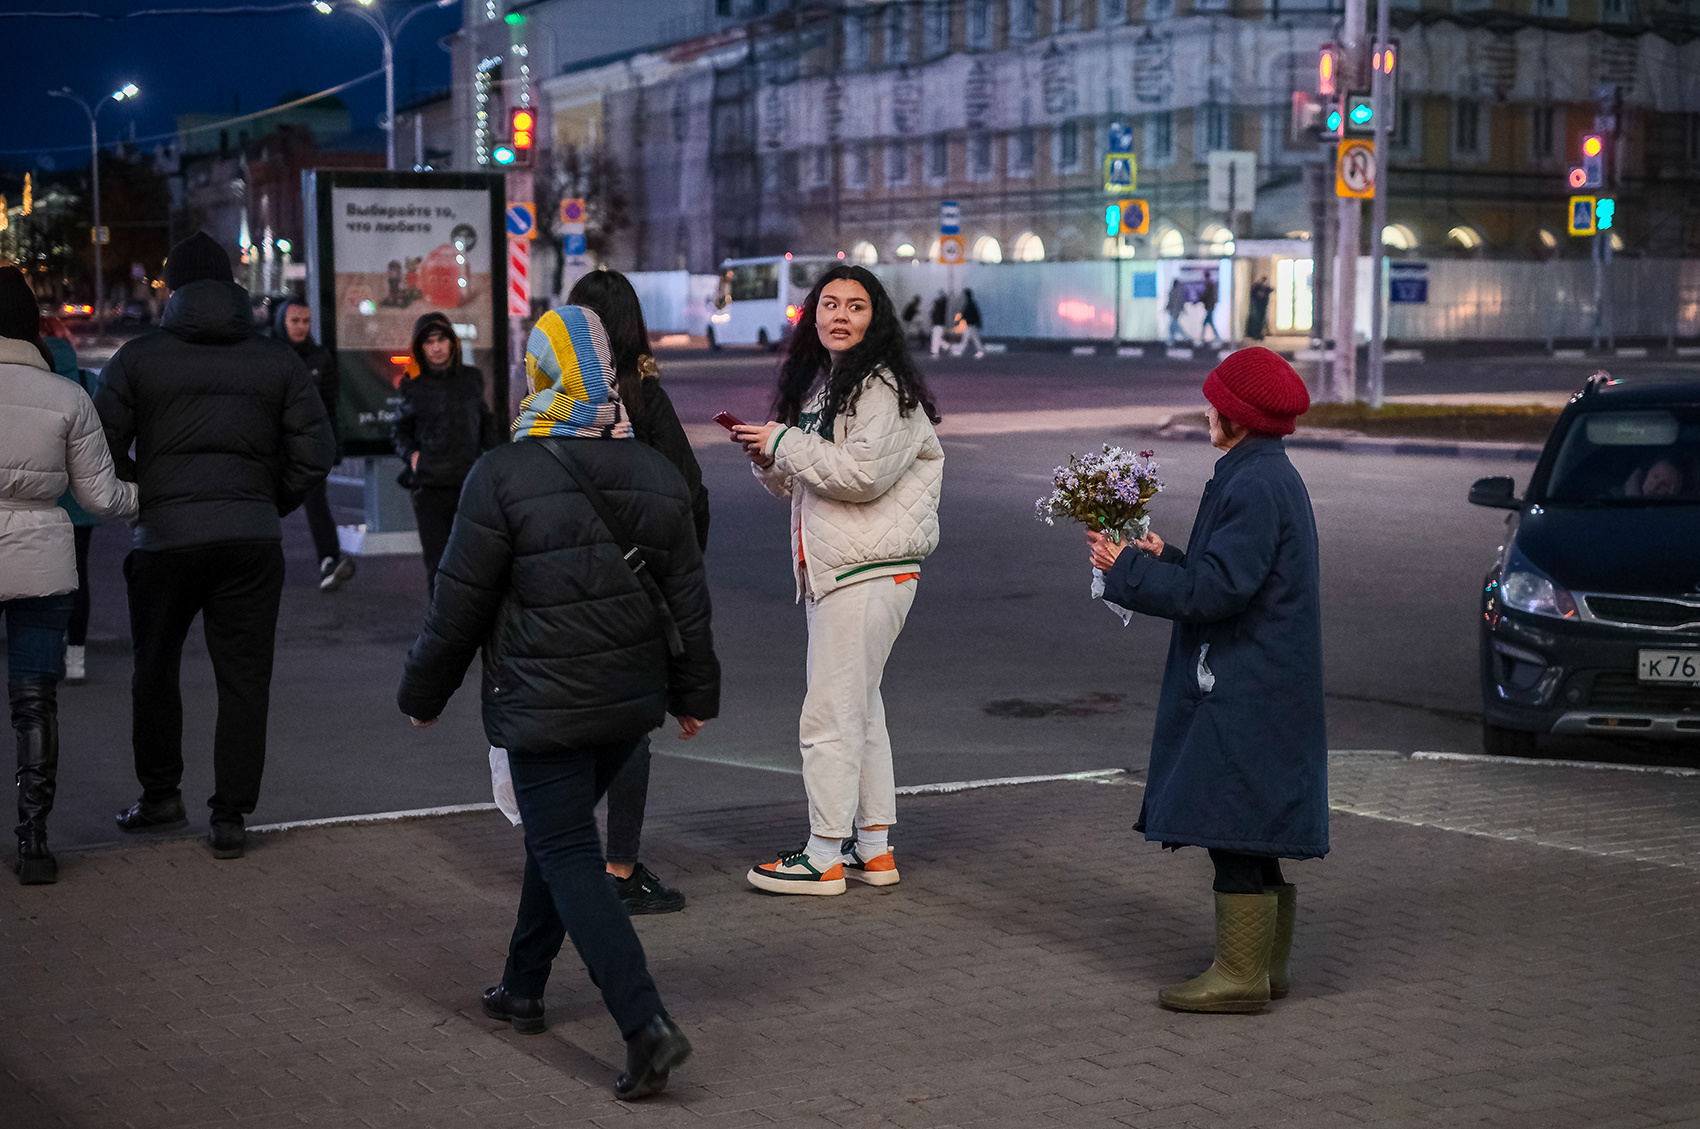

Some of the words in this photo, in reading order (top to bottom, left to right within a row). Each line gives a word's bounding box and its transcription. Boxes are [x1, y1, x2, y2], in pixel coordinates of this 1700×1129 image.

[346, 202, 431, 219] Выбирайте
[346, 222, 371, 232] что
[375, 220, 431, 232] любите
[1649, 655, 1700, 677] К76
